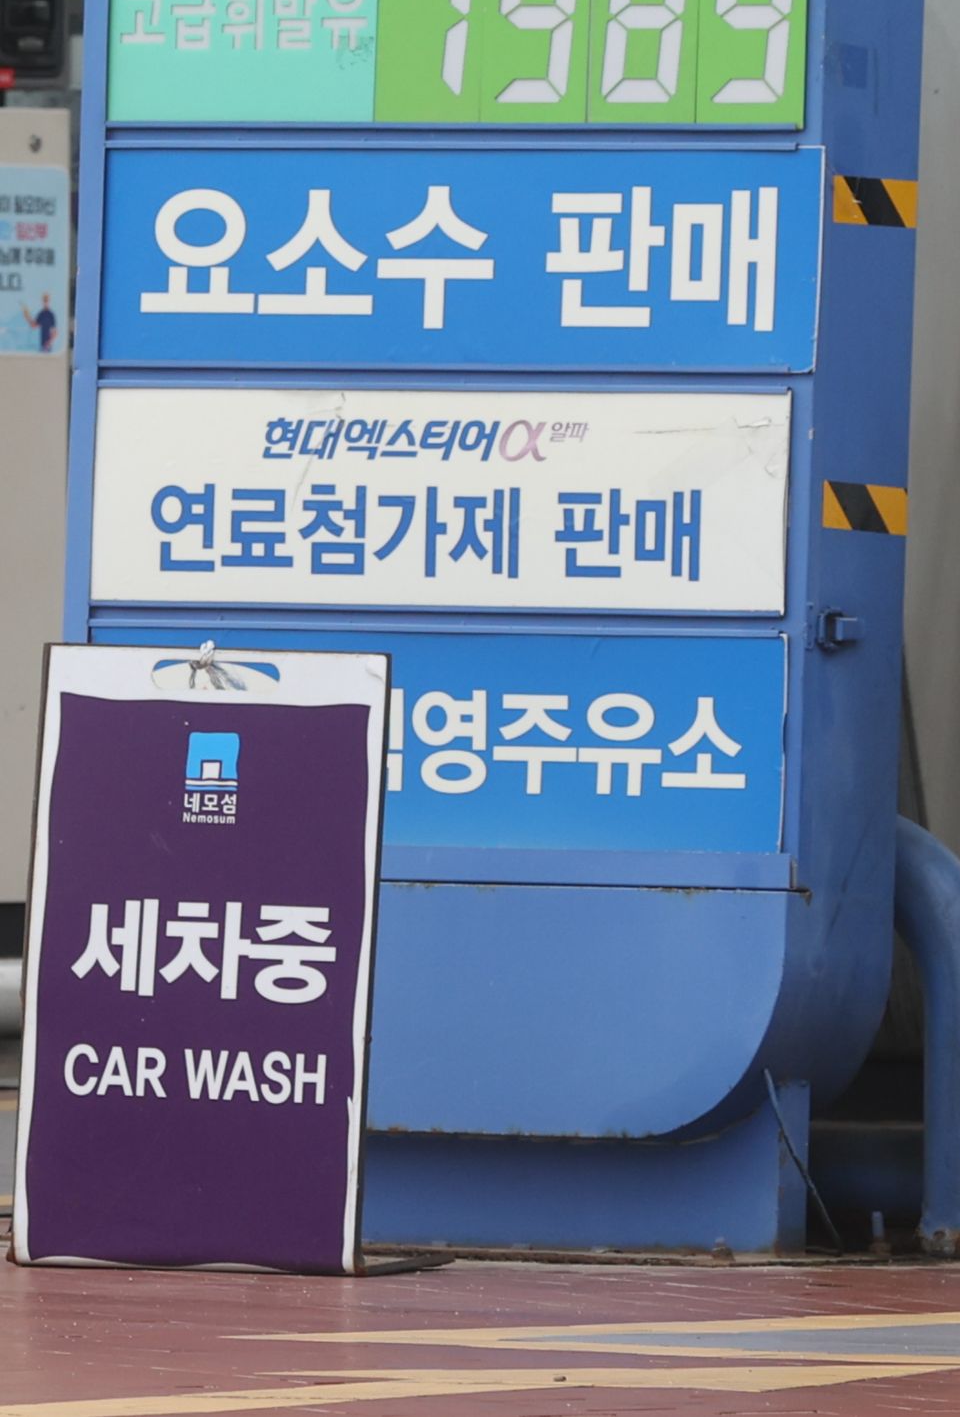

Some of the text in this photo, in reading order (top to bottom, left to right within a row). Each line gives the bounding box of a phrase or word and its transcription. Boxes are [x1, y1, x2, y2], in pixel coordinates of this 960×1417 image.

[139, 185, 779, 332] 요소수 판매
[150, 481, 703, 581] 연료첨가제 판매
[182, 812, 236, 824] Nemosum
[183, 792, 237, 814] 네모섬
[72, 898, 337, 1004] 세차중
[63, 1044, 328, 1105] CAR WASH
